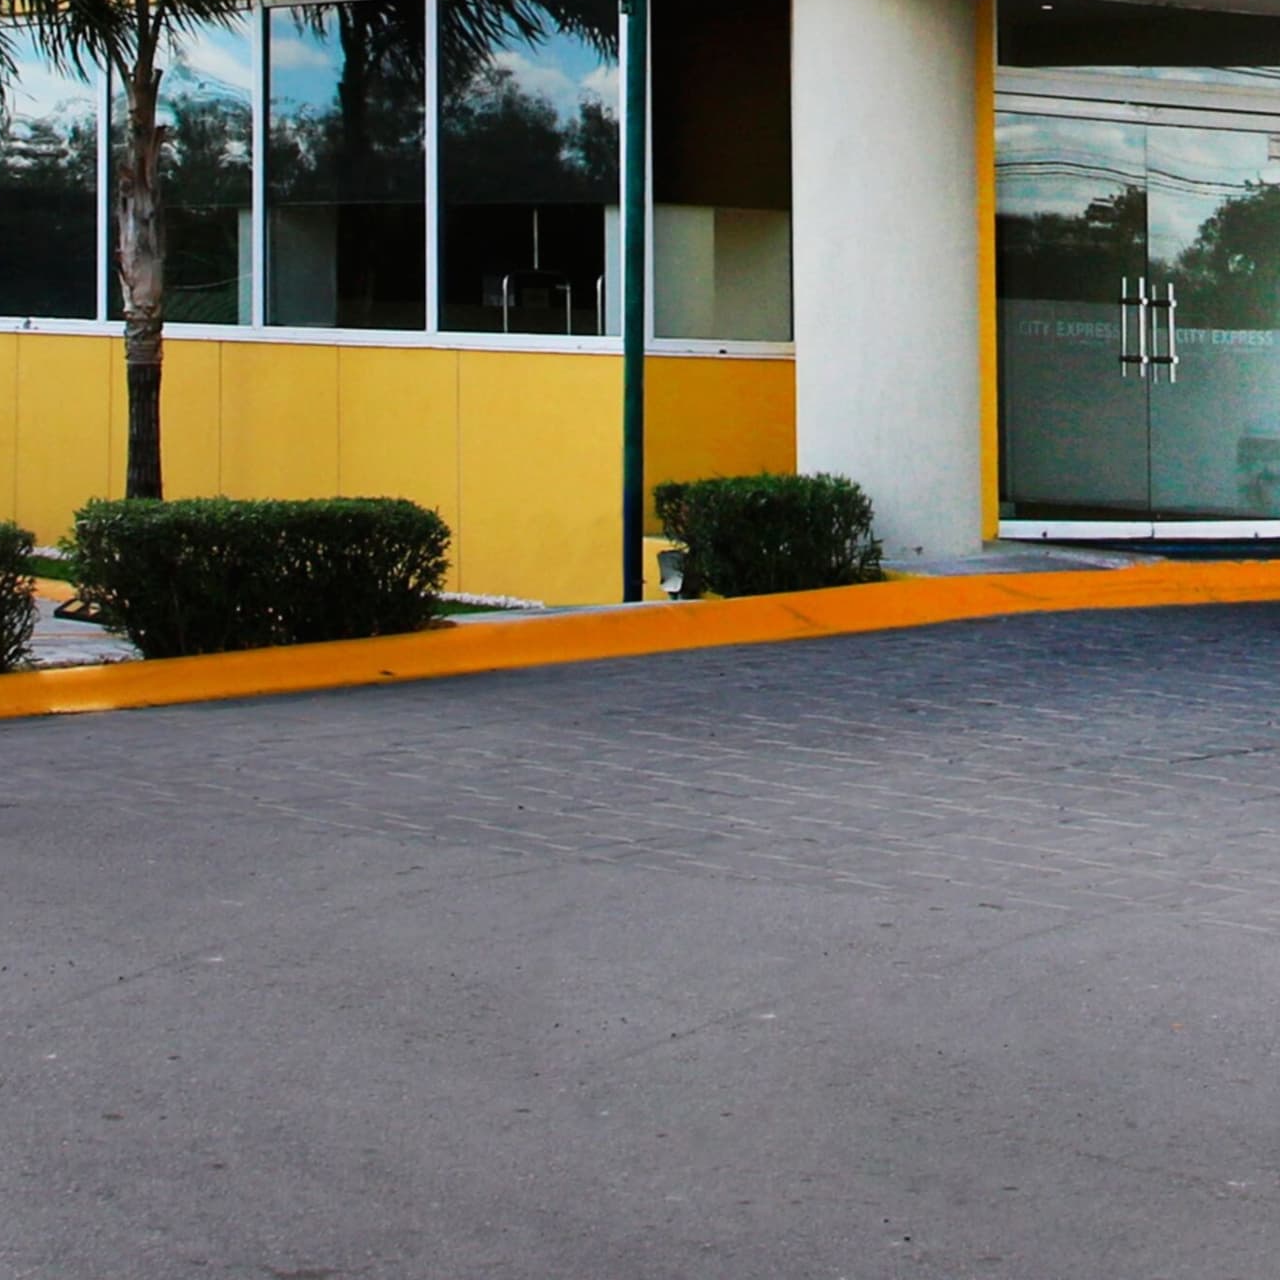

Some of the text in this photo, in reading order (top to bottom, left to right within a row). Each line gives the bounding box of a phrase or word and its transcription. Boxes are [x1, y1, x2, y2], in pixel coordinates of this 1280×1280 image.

[1019, 320, 1121, 339] CITY EXPRESS
[1176, 329, 1274, 346] CITY EXPRESS
